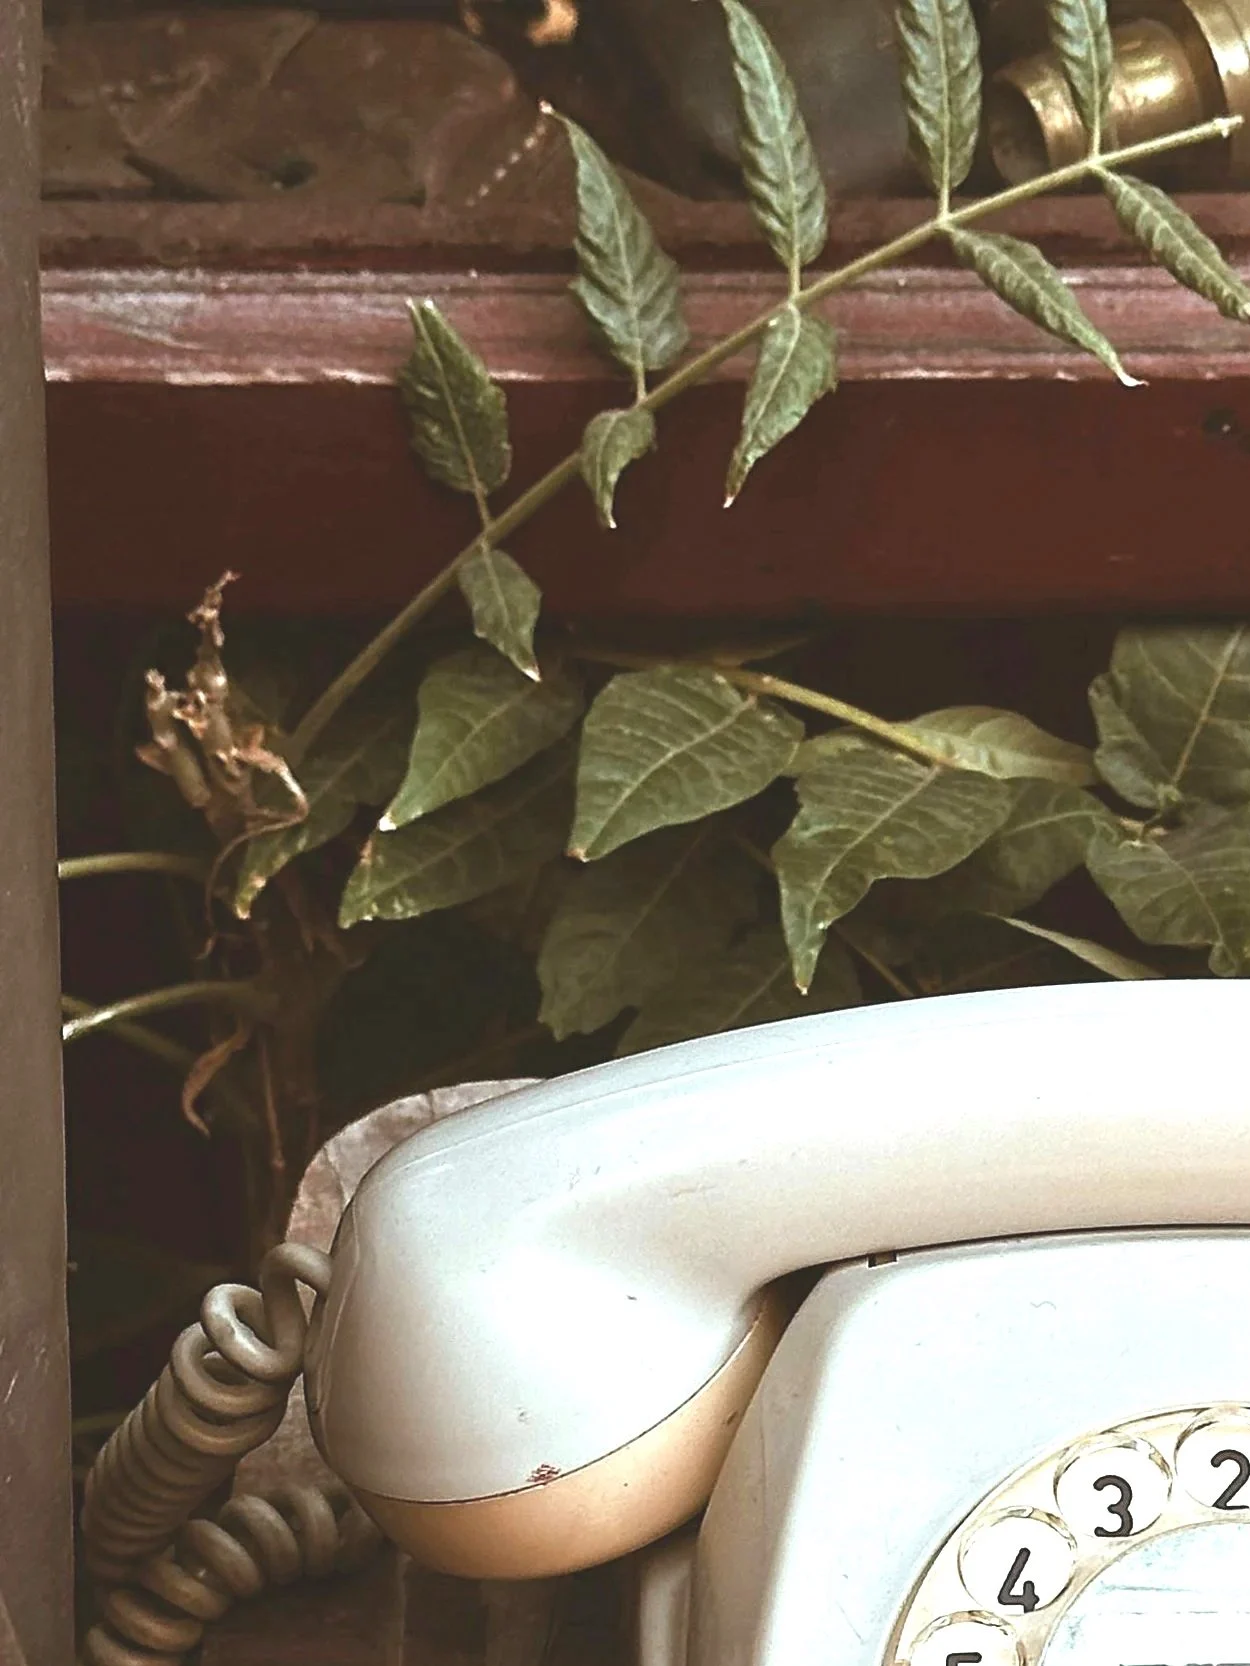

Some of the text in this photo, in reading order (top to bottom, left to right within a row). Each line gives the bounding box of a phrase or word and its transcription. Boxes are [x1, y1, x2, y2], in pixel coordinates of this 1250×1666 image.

[1093, 1475, 1133, 1537] 3
[1211, 1450, 1250, 1510] 2
[998, 1548, 1039, 1613] 4
